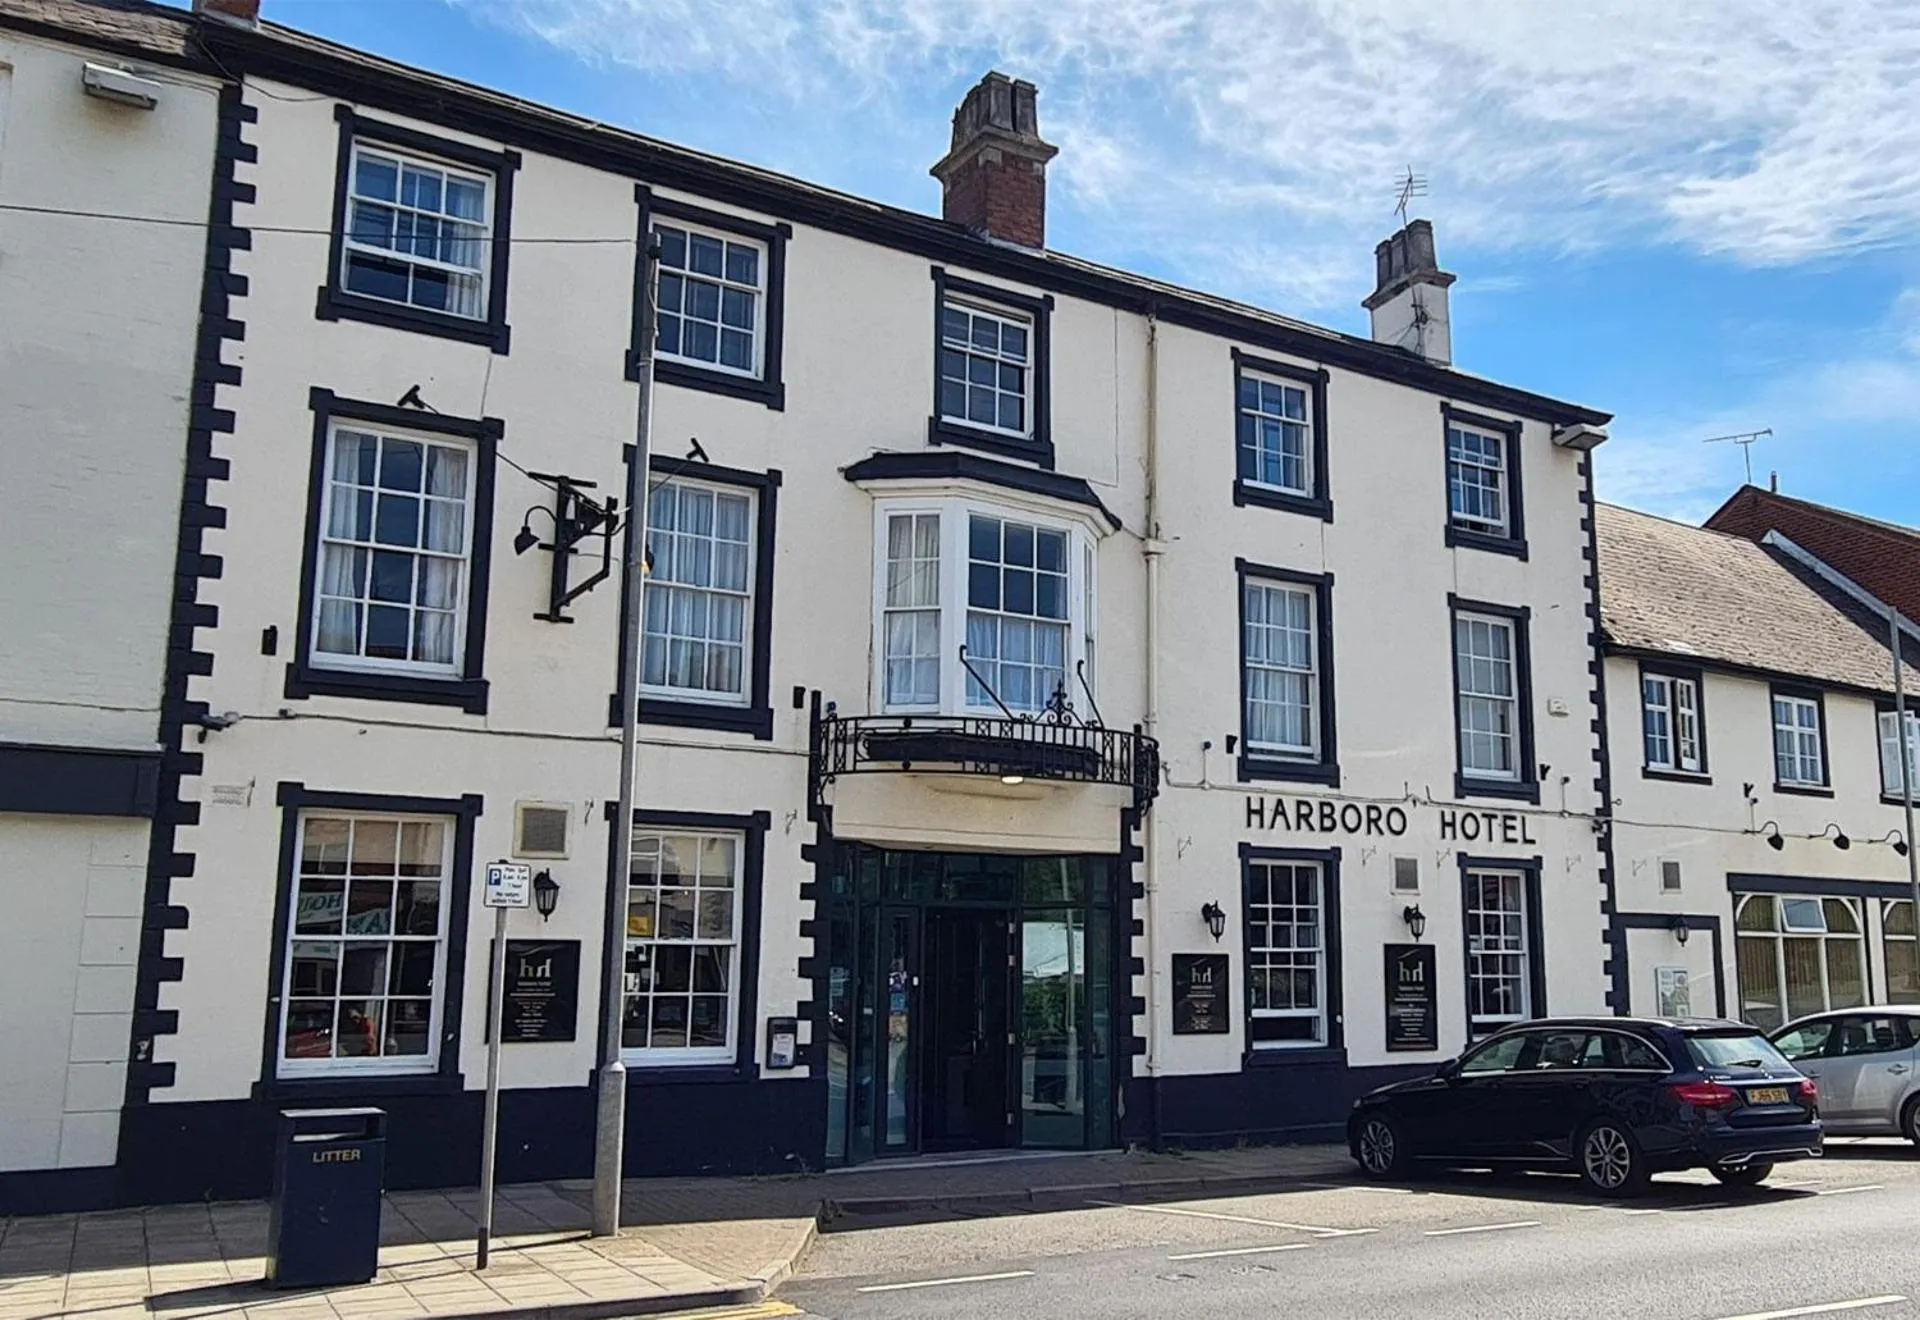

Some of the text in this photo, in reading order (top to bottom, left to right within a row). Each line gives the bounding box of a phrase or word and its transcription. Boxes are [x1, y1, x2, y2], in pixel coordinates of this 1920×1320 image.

[1246, 797, 1536, 845] HARBORO HOTEL
[312, 1149, 361, 1164] LITTER
